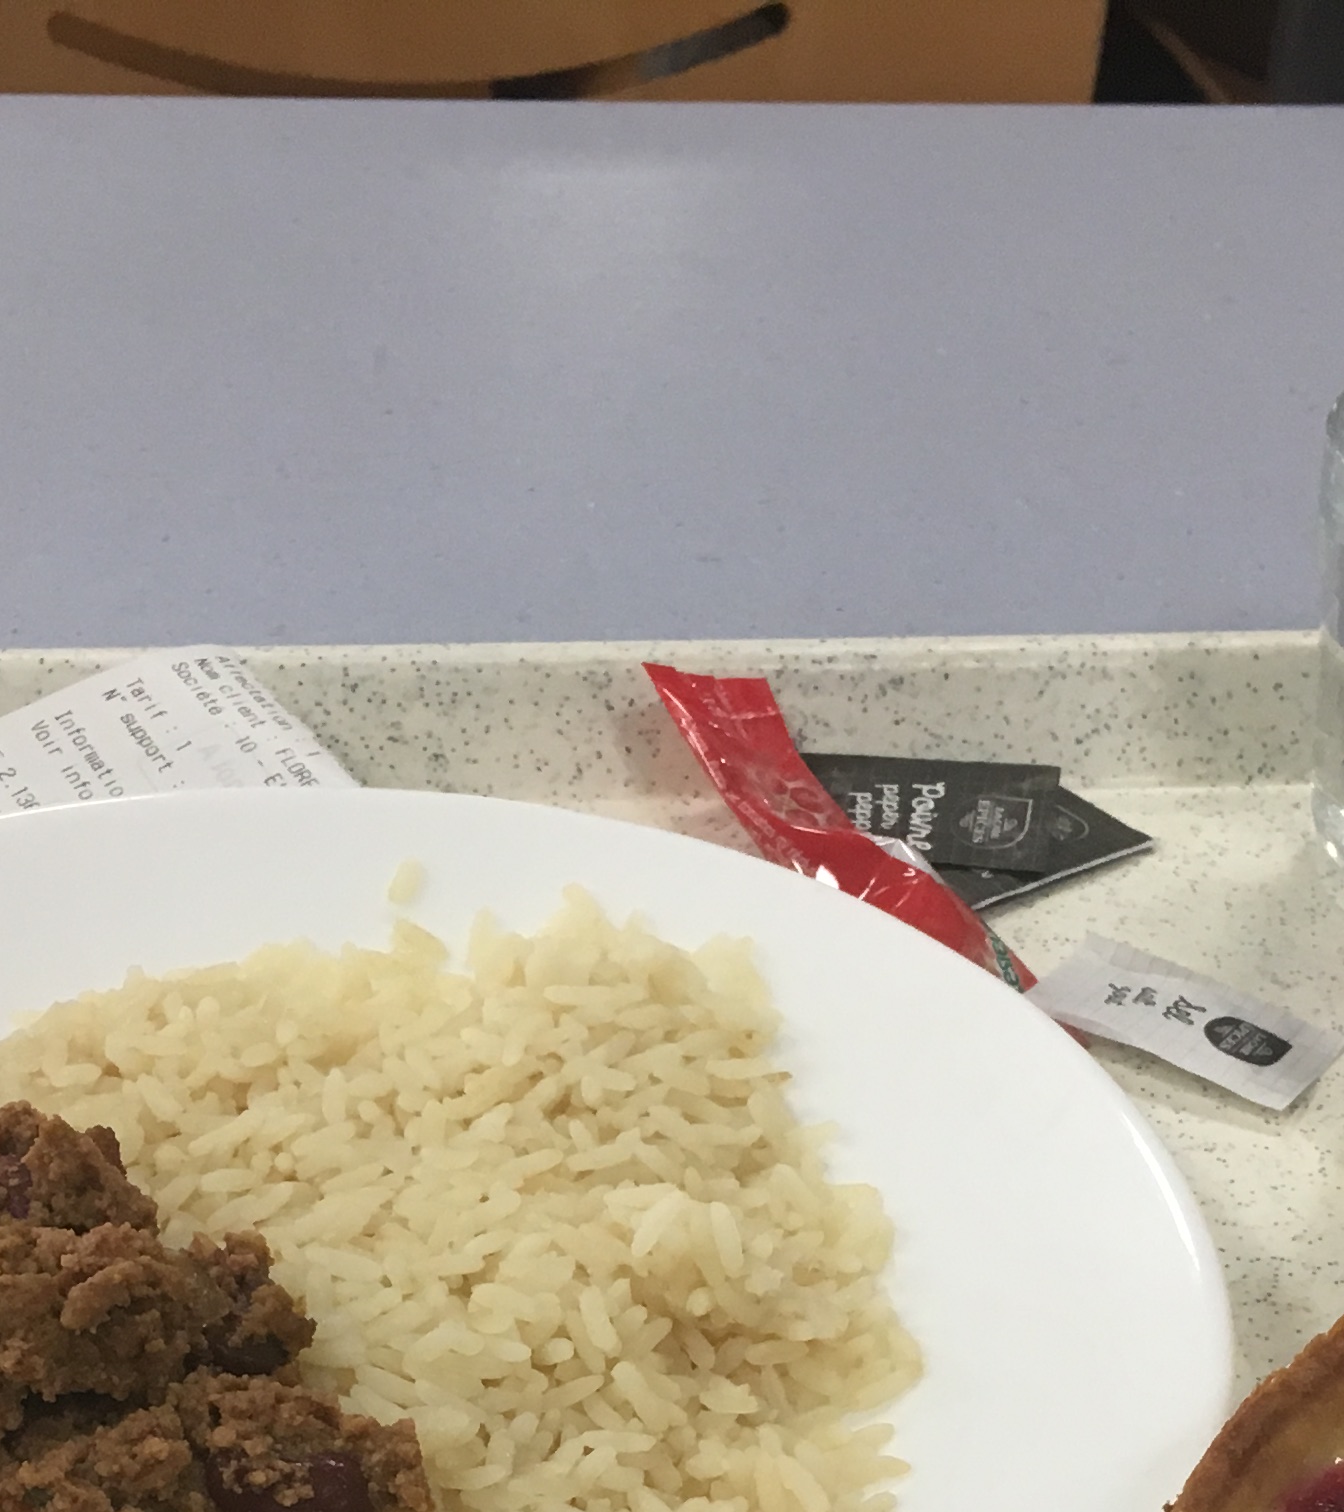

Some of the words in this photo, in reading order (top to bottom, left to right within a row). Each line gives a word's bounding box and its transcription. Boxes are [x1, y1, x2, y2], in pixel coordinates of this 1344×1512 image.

[101, 687, 129, 702] N°
[119, 712, 175, 774] support
[125, 676, 169, 720] Tarif
[171, 661, 224, 717] Société
[235, 735, 258, 754] 10
[194, 657, 222, 681] Nom
[218, 684, 267, 729] client
[30, 719, 64, 755] Voir
[60, 765, 95, 801] info
[53, 709, 125, 798] Informatio
[873, 783, 901, 830] peper
[905, 781, 946, 851] Poivre
